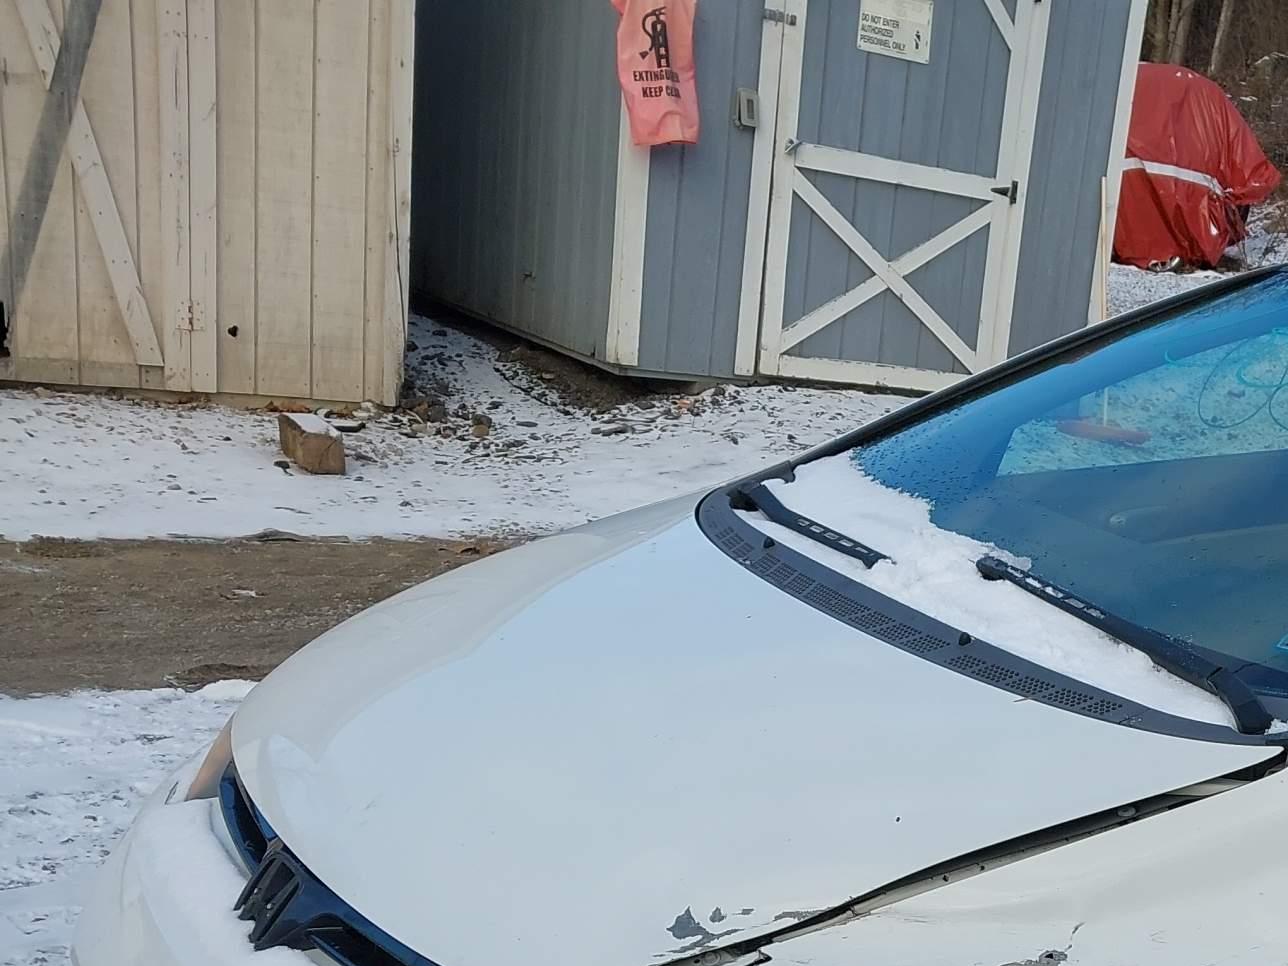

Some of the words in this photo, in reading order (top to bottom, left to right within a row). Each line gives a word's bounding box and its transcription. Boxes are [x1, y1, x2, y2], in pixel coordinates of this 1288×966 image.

[861, 12, 870, 22] DO
[871, 14, 881, 25] NOT
[882, 17, 900, 29] ENTER
[861, 23, 894, 38] AUTHORIZED
[642, 85, 664, 98] KEEP
